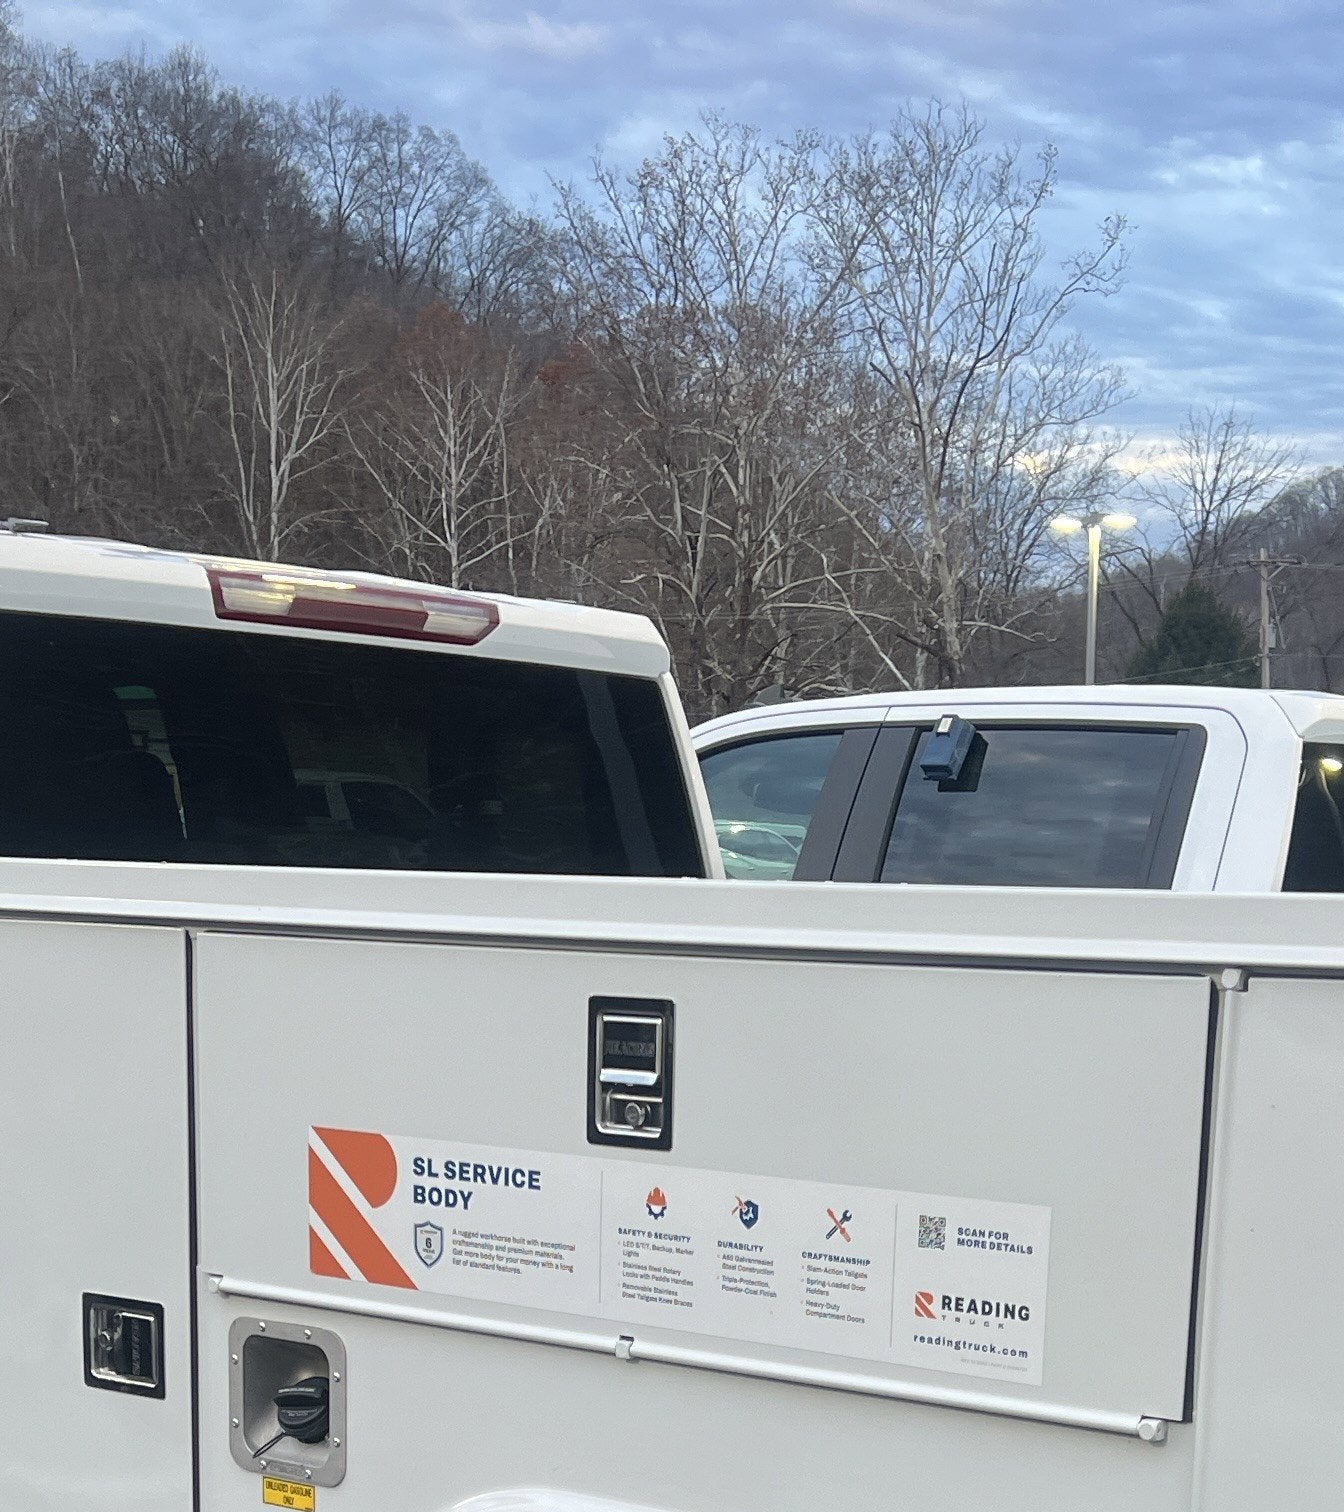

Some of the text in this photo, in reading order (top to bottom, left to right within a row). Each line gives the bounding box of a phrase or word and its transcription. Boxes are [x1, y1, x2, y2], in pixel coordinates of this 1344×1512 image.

[412, 1156, 542, 1191] SL SERVICE
[412, 1184, 474, 1211] BODY
[618, 1227, 646, 1237] SAFETY
[654, 1231, 691, 1243] SECURITY
[956, 1226, 1010, 1242] SCAN FOR
[717, 1240, 763, 1253] DURABILITY
[956, 1237, 1033, 1255] MORE DETAILS
[801, 1251, 871, 1266] CRAFTSMANSHIP
[941, 1294, 1031, 1322] READING
[913, 1333, 1029, 1359] readingtruck.com
